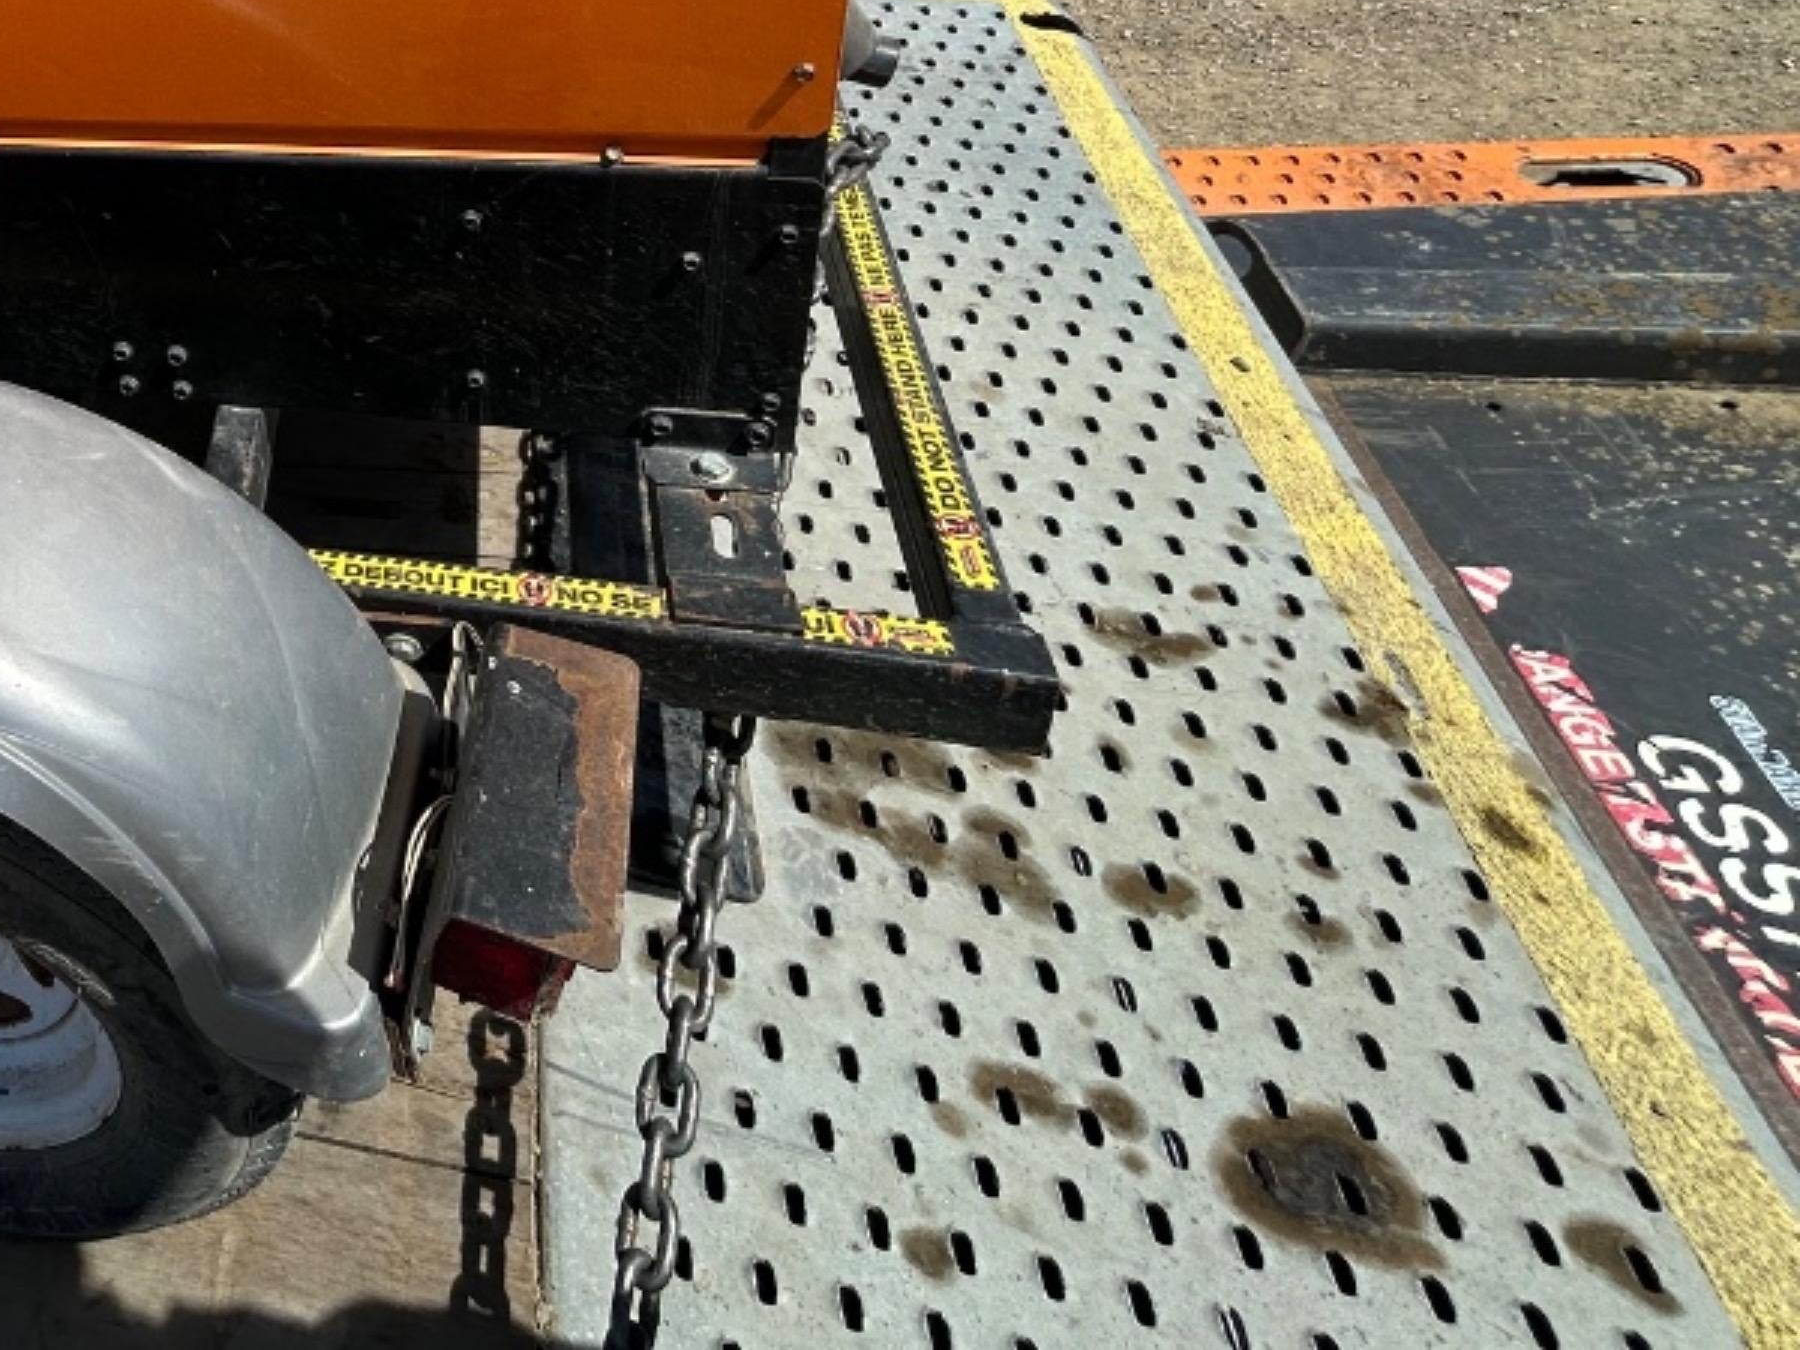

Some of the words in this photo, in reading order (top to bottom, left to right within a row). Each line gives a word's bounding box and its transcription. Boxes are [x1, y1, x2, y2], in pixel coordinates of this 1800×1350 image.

[878, 306, 905, 356] HERE
[918, 427, 949, 472] NOT
[935, 476, 960, 510] DO
[342, 561, 464, 592] DEBOUT
